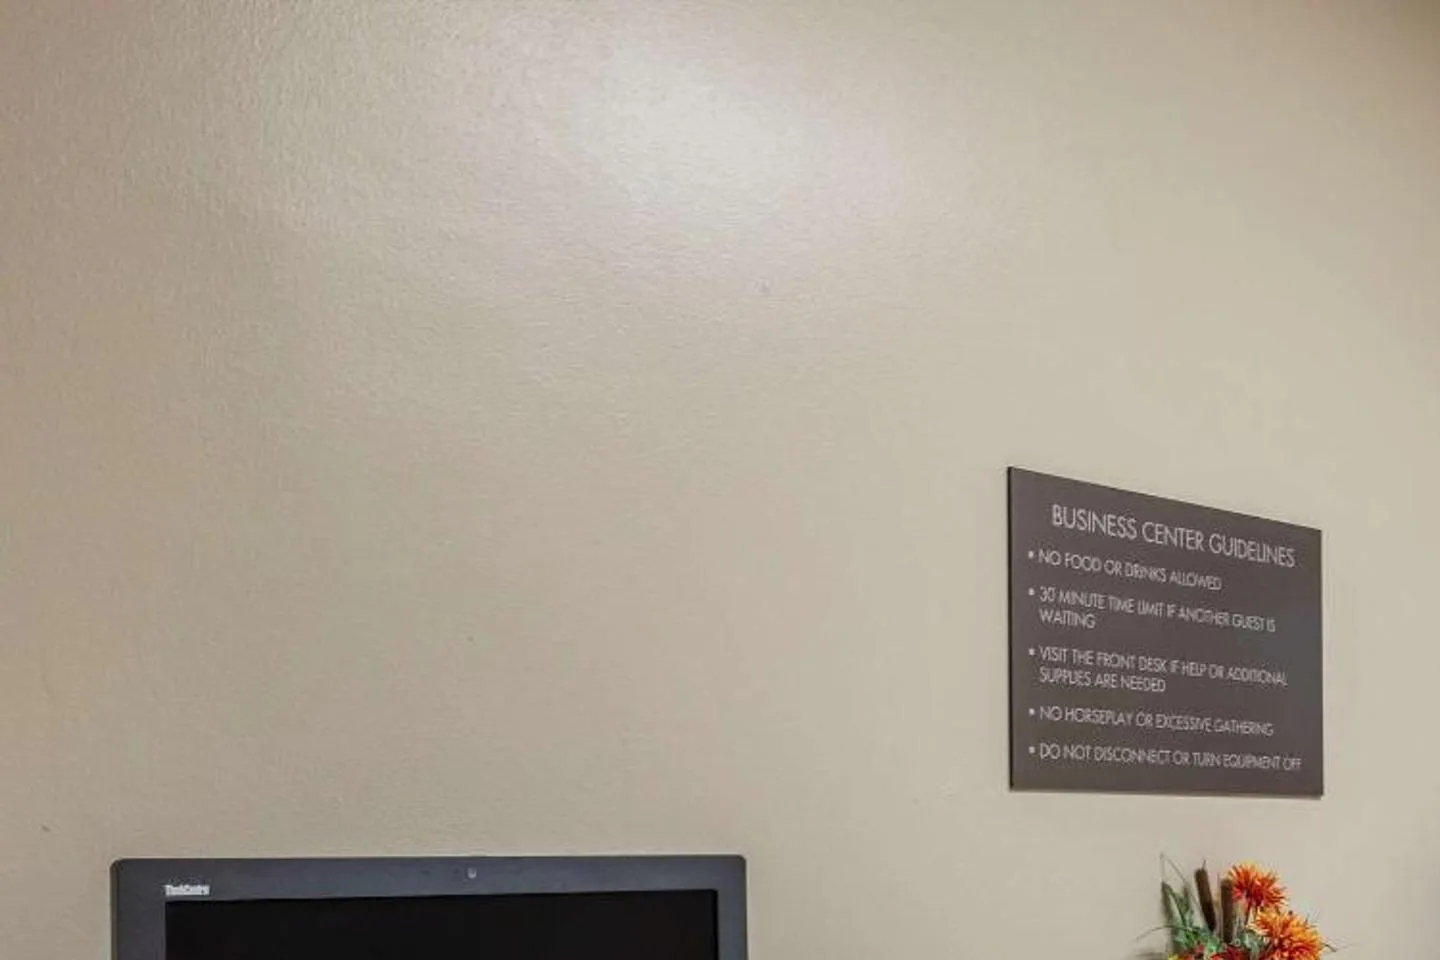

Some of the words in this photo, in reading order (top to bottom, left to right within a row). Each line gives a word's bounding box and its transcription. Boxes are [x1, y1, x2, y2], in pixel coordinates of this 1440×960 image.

[1052, 503, 1137, 540] BUSINESS
[1141, 521, 1205, 552] CENTER
[1208, 533, 1295, 568] GUIDELINES
[1039, 549, 1061, 566] NO
[1065, 552, 1102, 572] FOOD
[1104, 559, 1122, 576] OR
[1124, 562, 1167, 582] DRINKS
[1169, 570, 1222, 591] ALLOWED
[1039, 586, 1056, 603] 30
[1058, 589, 1106, 610] MINUTE
[1108, 595, 1135, 613] TIME
[1137, 600, 1165, 617] LIMIT
[1167, 603, 1177, 618] IF
[1178, 607, 1230, 628] ANOTHER
[1231, 613, 1264, 632] GUEST
[1266, 616, 1277, 633] IS
[1039, 608, 1096, 629] WAITING
[1039, 645, 1069, 664] VISIT
[1072, 648, 1095, 666] THE
[1097, 651, 1137, 670] FRONT
[1138, 655, 1168, 673] DESK
[1170, 659, 1180, 674] IF
[1182, 661, 1207, 677] HELP
[1208, 663, 1225, 679] OR
[1227, 667, 1288, 687] ADDITIONAL
[1039, 665, 1092, 687] SUPPLIES
[1094, 672, 1118, 689] ARE
[1120, 675, 1167, 692] NEEDED
[1039, 705, 1062, 722] NO
[1064, 706, 1134, 726] HORSEPLAY
[1135, 711, 1153, 728] OR
[1155, 713, 1212, 733] EXCESSIVE
[1213, 719, 1275, 737] GATHERING
[1039, 742, 1061, 761] DO
[1062, 744, 1092, 761] NOT
[1094, 746, 1172, 765] DISCONNECT
[1172, 750, 1190, 767] OR
[1191, 751, 1221, 768] TURN
[1222, 753, 1281, 769] EQUIPMENT
[1282, 756, 1302, 771] OFF
